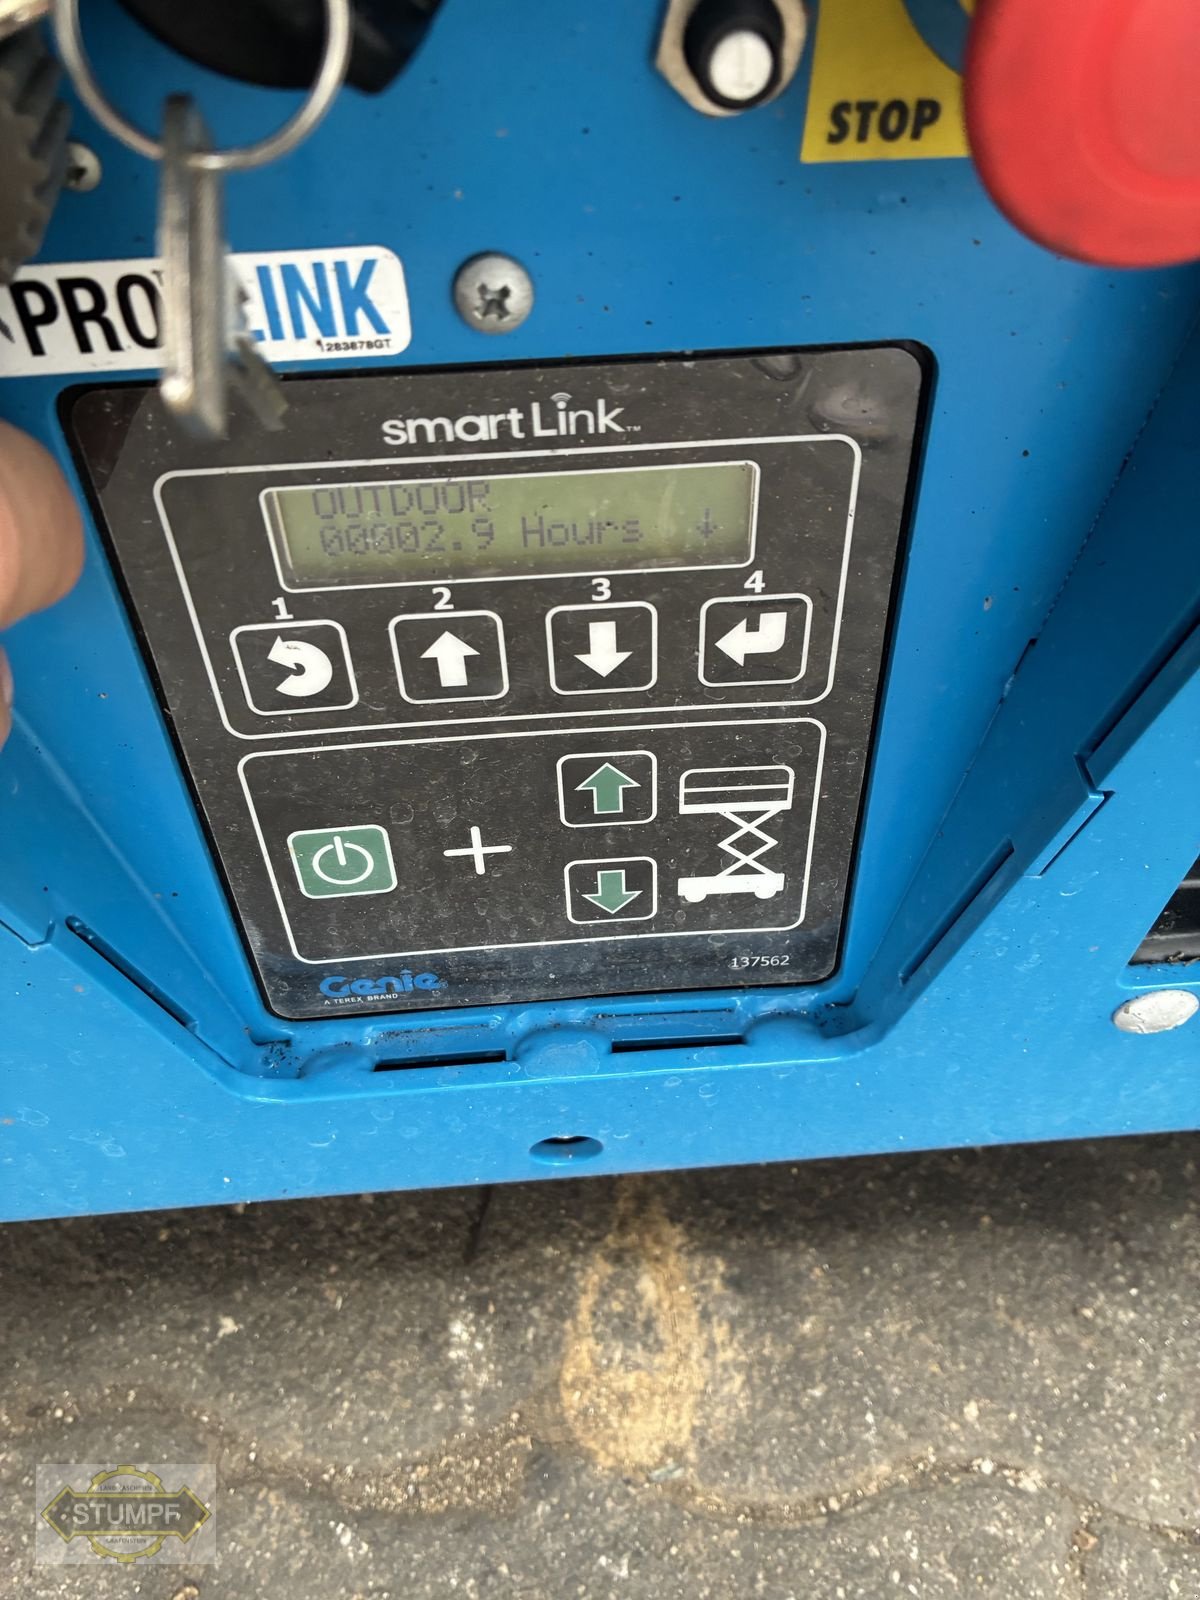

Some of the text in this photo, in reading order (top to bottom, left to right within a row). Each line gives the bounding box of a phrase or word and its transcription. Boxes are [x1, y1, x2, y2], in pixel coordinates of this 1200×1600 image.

[827, 98, 942, 144] STOP
[8, 274, 166, 356] PRO
[245, 258, 391, 342] INK
[312, 479, 492, 520] OUTDOOR
[319, 514, 644, 557] 00002.9 Hours
[590, 577, 612, 602] 3
[743, 570, 766, 594] 4
[271, 597, 294, 620] 1
[431, 586, 455, 611] 2
[731, 955, 790, 968] 137562
[319, 969, 441, 999] Genie
[334, 996, 363, 1004] TEREX
[367, 993, 398, 1002] BRAND
